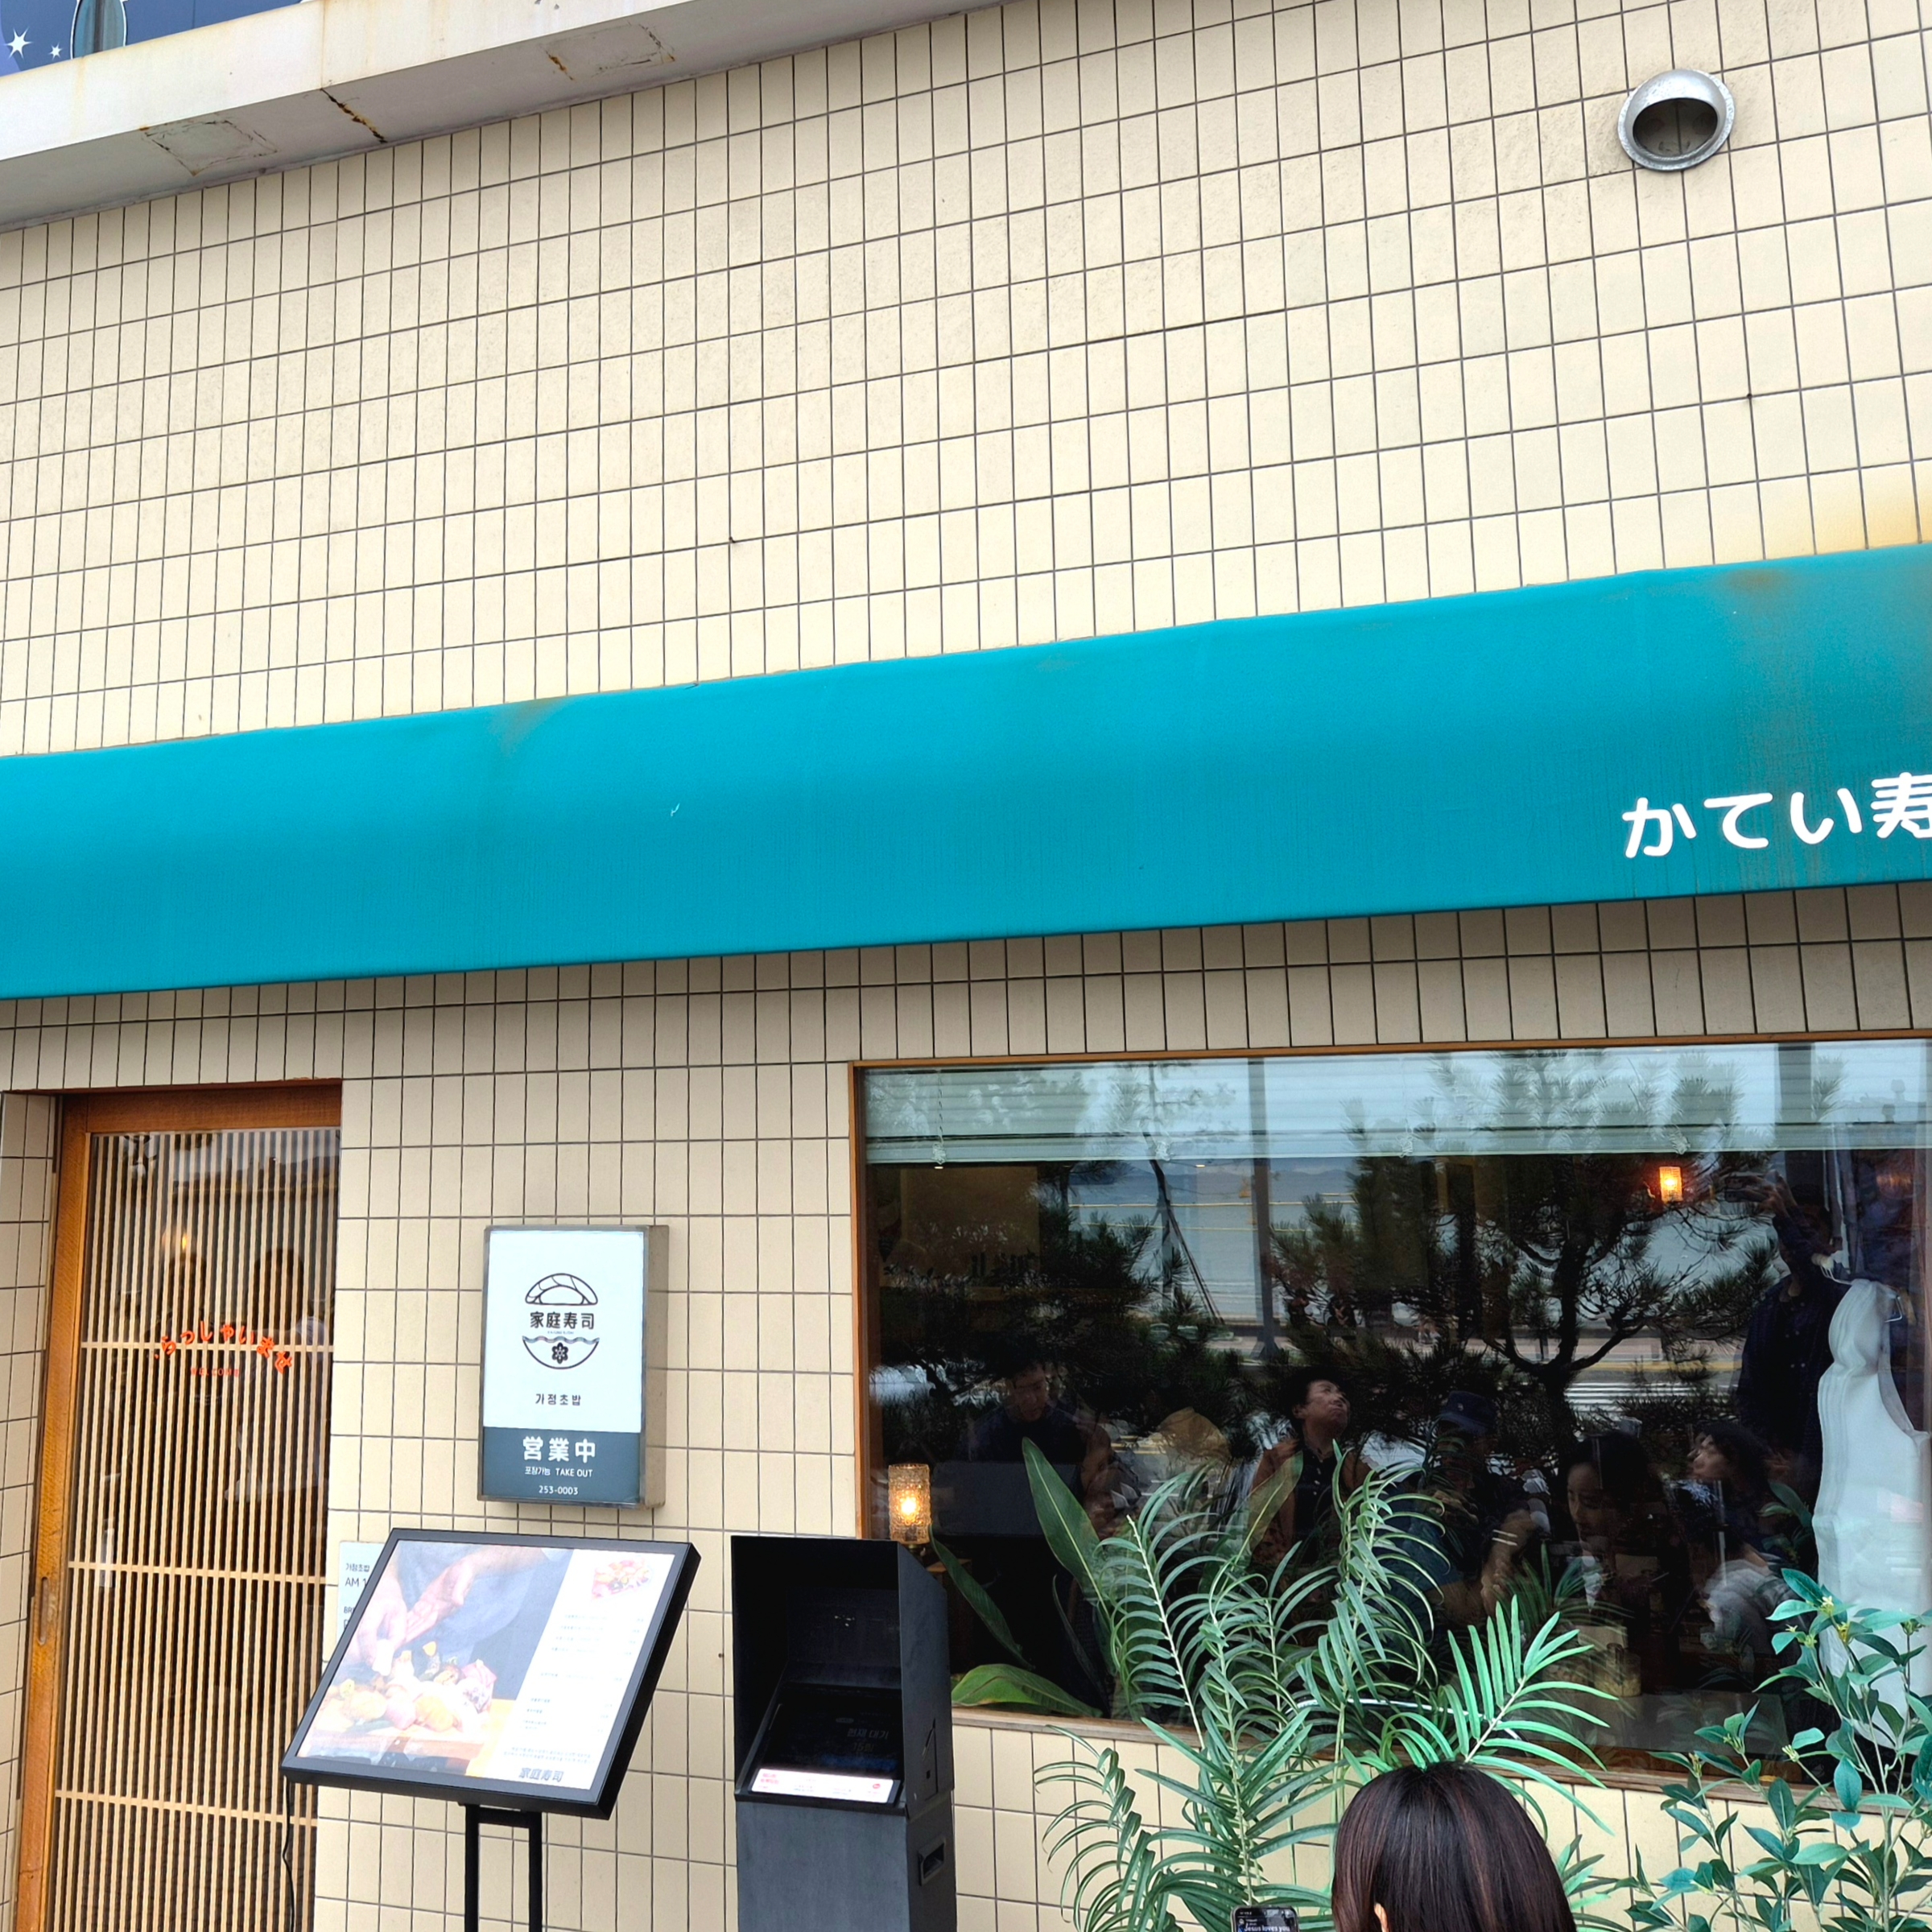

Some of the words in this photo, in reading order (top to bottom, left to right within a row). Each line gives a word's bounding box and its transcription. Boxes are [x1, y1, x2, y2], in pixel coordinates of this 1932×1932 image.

[530, 1311, 595, 1330] 家庭寿司
[154, 1320, 292, 1374] らっしゃいませ
[535, 1393, 581, 1406] 가정초밥
[522, 1435, 596, 1463] 営業中
[555, 1468, 575, 1477] TAKE
[576, 1469, 593, 1477] OUT
[539, 1484, 579, 1495] 253-0003
[345, 1577, 360, 1587] AM
